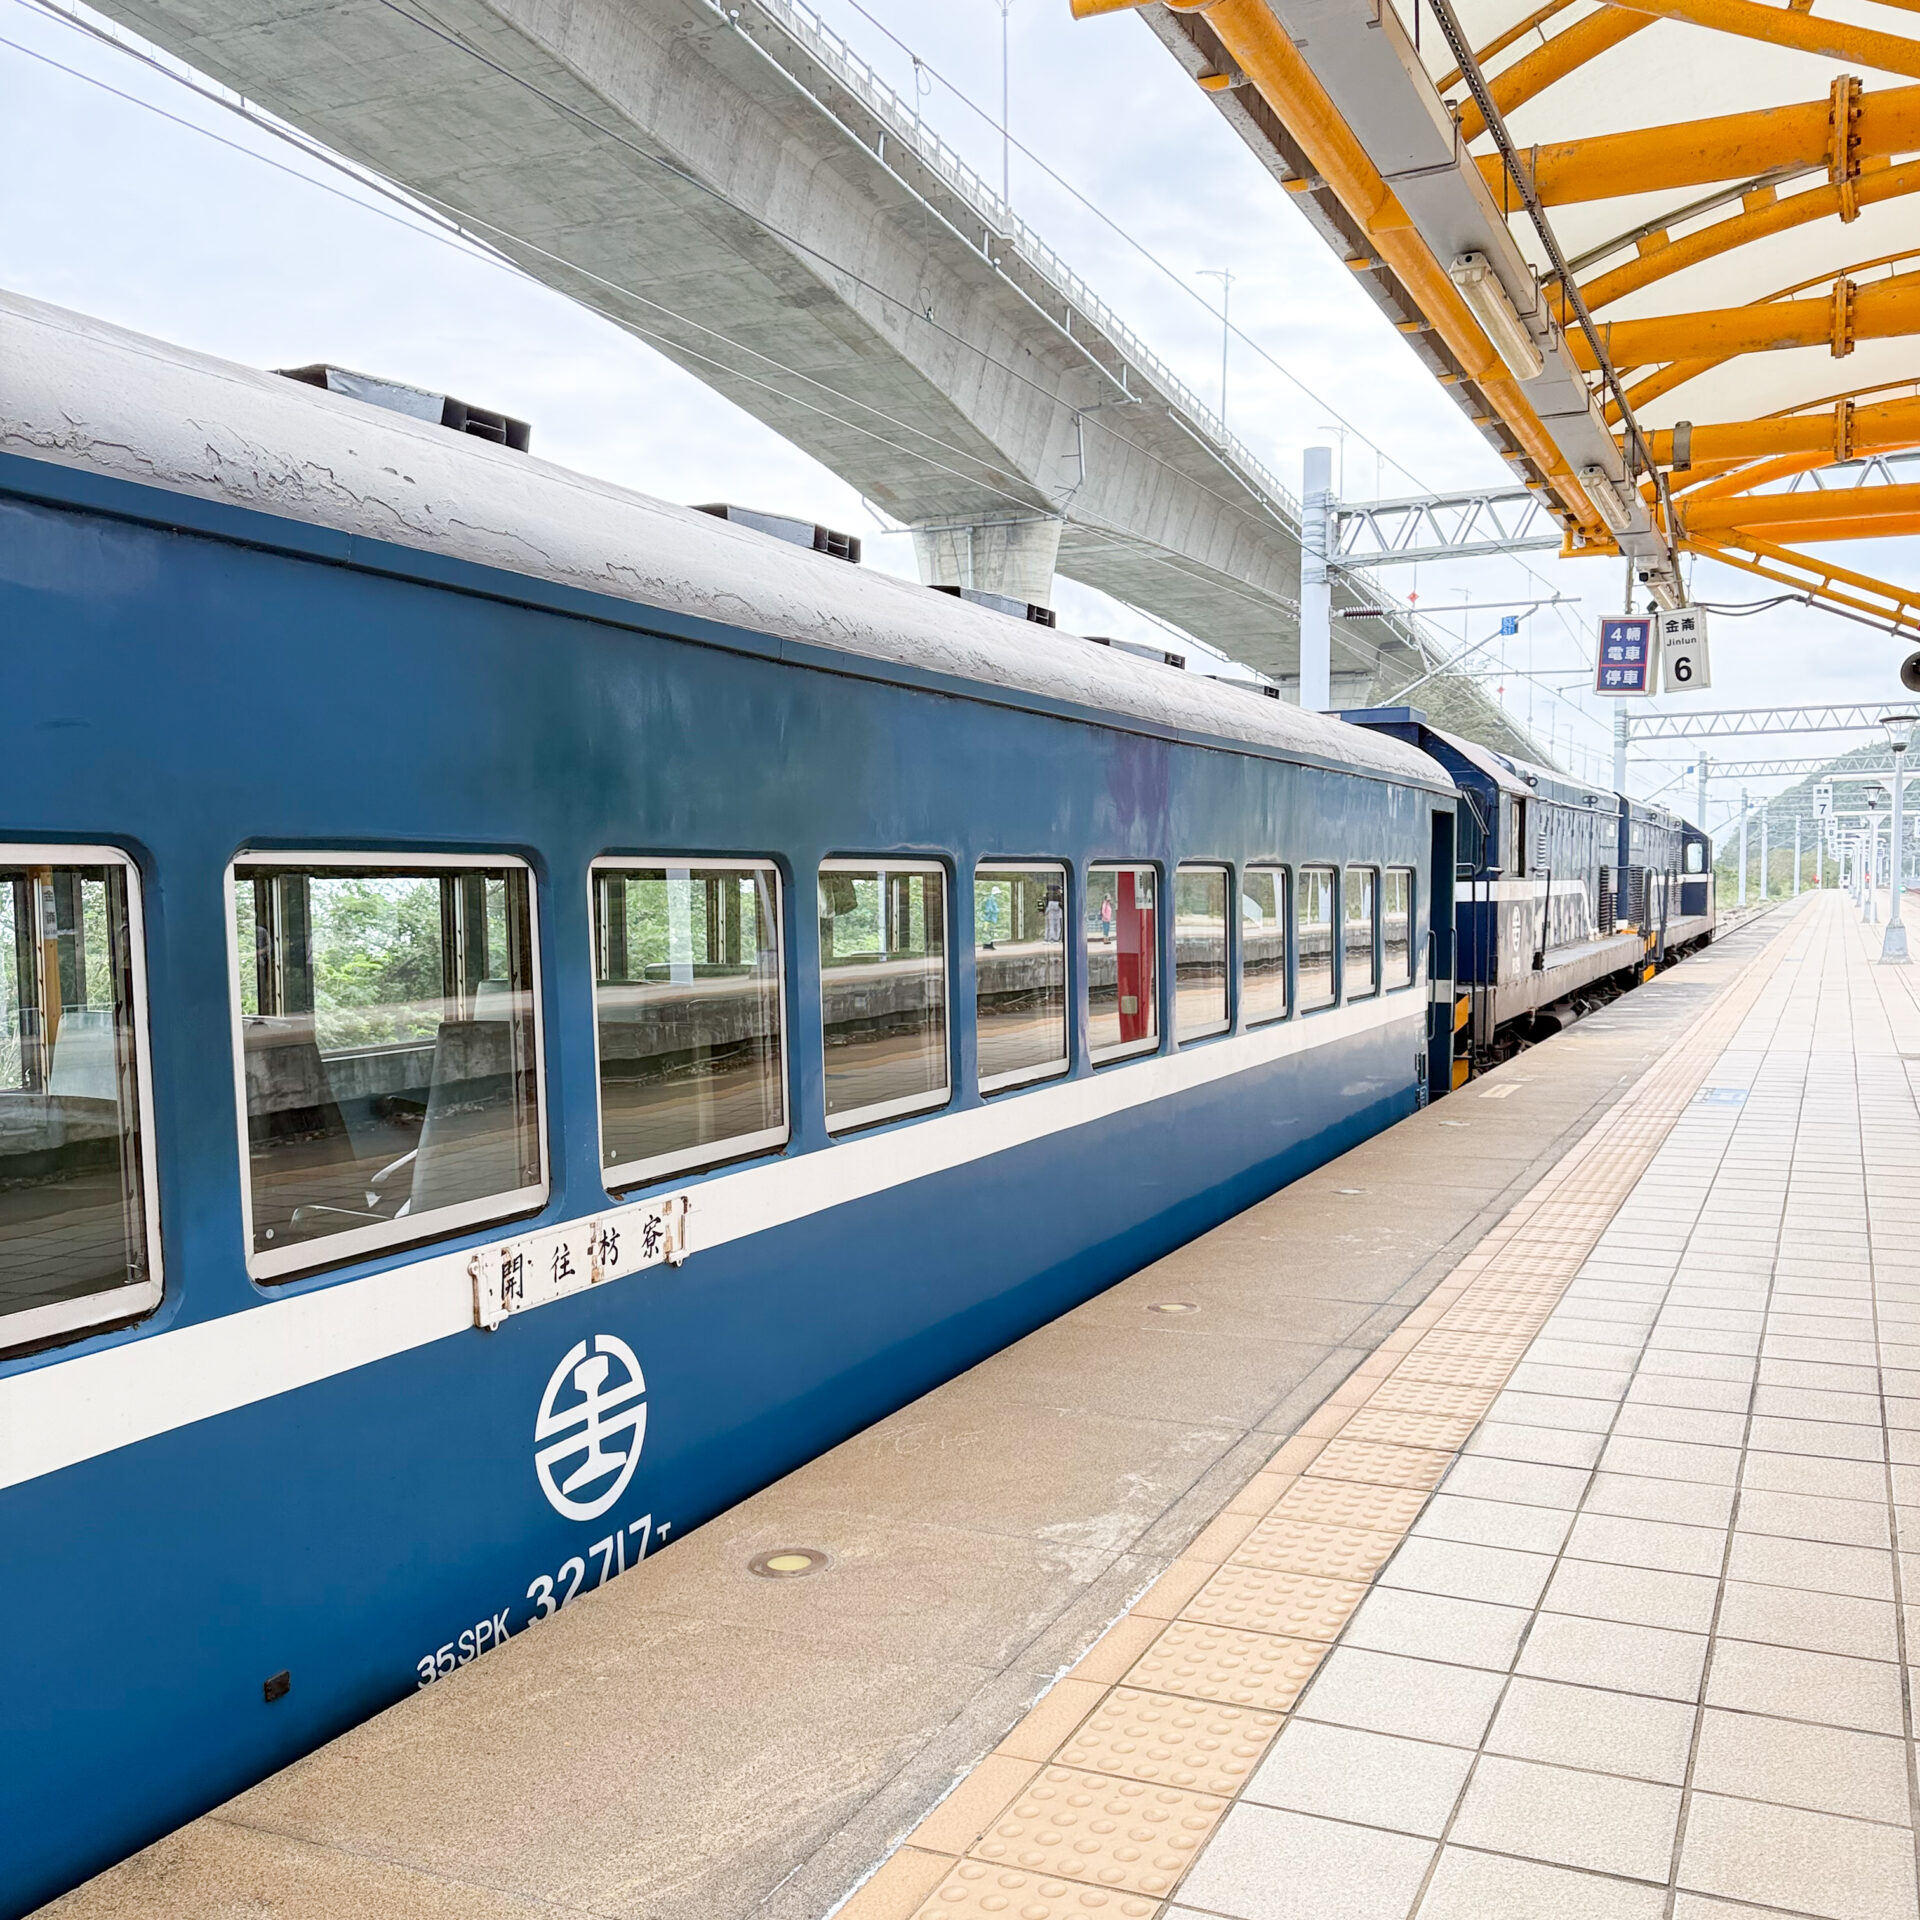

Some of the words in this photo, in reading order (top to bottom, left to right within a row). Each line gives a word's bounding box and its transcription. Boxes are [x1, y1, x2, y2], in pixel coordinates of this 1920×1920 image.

[1665, 617, 1695, 633] 金崙
[1666, 637, 1697, 647] Jinlun
[1607, 646, 1641, 661] 電車
[1674, 656, 1693, 682] 6
[1605, 670, 1639, 686] 停車
[1818, 803, 1828, 815] 7
[501, 1213, 664, 1300] 開往枋寮
[416, 1607, 511, 1689] 35SPK
